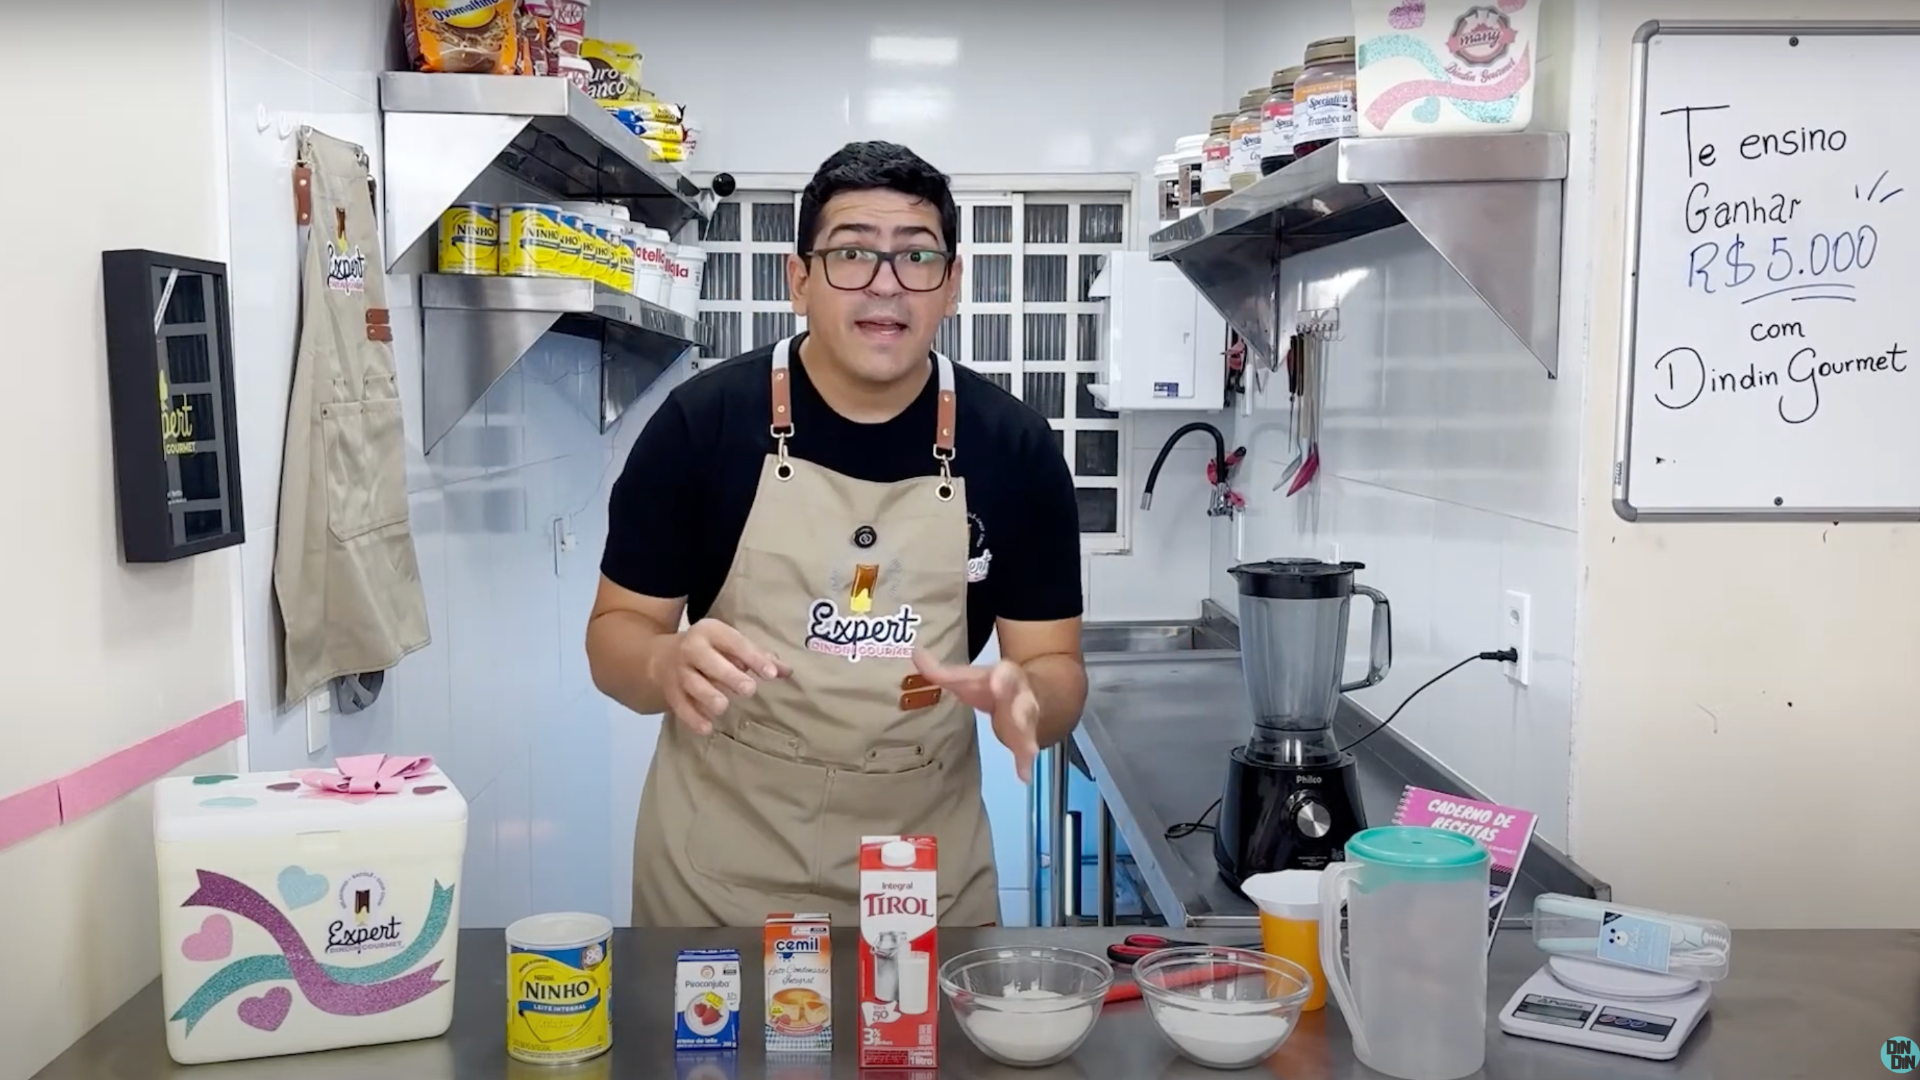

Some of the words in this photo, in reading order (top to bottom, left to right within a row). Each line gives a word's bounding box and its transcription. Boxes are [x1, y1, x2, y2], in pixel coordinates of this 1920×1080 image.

[1460, 30, 1501, 48] many
[1660, 104, 1731, 178] Te
[1739, 126, 1848, 160] ensino
[1685, 181, 1802, 234] Ganhar
[456, 224, 495, 237] NINHO
[525, 228, 559, 239] NINHO
[1750, 320, 1806, 342] com
[1655, 346, 1779, 410] Dindin
[1778, 343, 1908, 424] Gourmet
[805, 601, 919, 660] Expert
[858, 646, 913, 657] GOURME
[1296, 774, 1323, 784] Philco
[1427, 799, 1494, 824] CADERNO
[1492, 812, 1517, 829] DE
[1430, 816, 1500, 842] RECEITAS
[881, 881, 914, 891] Integral
[863, 891, 935, 918] TIROL
[324, 915, 403, 955] Expert
[775, 937, 819, 951] cemil
[361, 940, 403, 951] GOURMET
[524, 980, 590, 1000] NINHO
[533, 1003, 553, 1011] LEITE
[554, 1003, 587, 1012] INTEGRAL
[872, 1009, 889, 1022] 50
